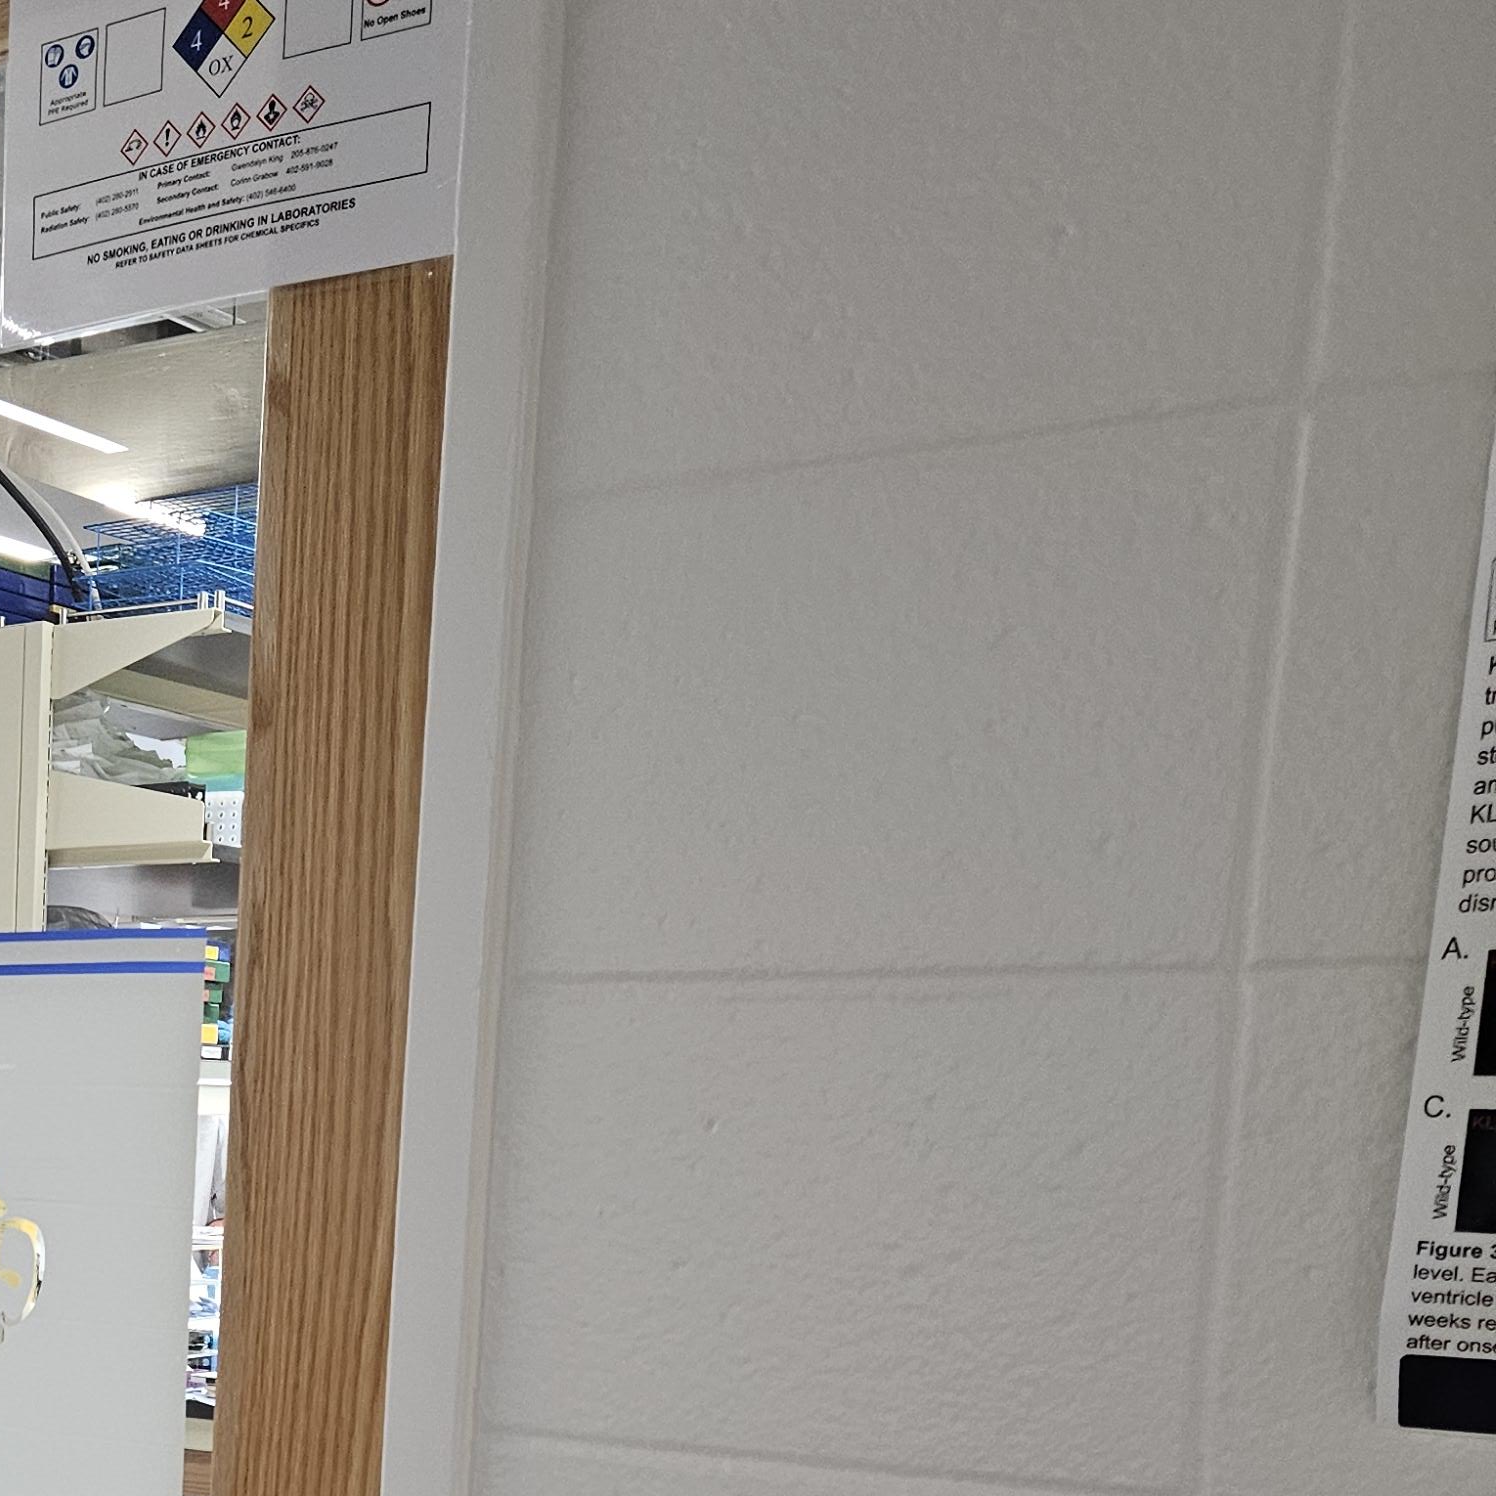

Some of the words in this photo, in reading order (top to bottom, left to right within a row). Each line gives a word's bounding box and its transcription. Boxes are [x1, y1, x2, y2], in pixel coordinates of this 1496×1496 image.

[241, 16, 253, 39] 2
[364, 18, 375, 28] No
[377, 13, 398, 27] Open
[400, 6, 426, 19] Shoes
[190, 29, 203, 51] 4
[208, 54, 234, 76] OX
[138, 170, 148, 181] IN
[150, 165, 174, 179] CASE
[176, 160, 189, 171] OF
[191, 145, 250, 168] EMERGENCY
[252, 134, 301, 154] CONTACT:
[157, 177, 181, 190] Primary
[184, 171, 211, 184] Contact:
[87, 253, 100, 265] NO
[102, 241, 148, 262] SMOKING,
[151, 232, 186, 249] EATING
[188, 228, 203, 241] OR
[205, 217, 255, 237] DRINKING
[257, 214, 268, 227] IN
[271, 197, 356, 225] LABORATORIES
[115, 256, 137, 269] REFER
[139, 253, 148, 264] TO
[149, 246, 175, 261] SAFETY
[176, 243, 194, 256] DATA
[195, 238, 223, 251] SHEETS
[224, 235, 239, 245] FOR
[240, 226, 278, 242] CHEMICAL
[280, 218, 320, 234] SPECIFICS
[1441, 936, 1469, 960] A.
[1451, 986, 1475, 1063] Wild-type
[1424, 1095, 1451, 1118] C.
[1432, 1145, 1456, 1220] Wild-type
[1416, 1240, 1483, 1261] Figure
[1413, 1264, 1464, 1282] level.
[1411, 1289, 1494, 1308] ventricle
[1408, 1313, 1472, 1330] weeks
[1406, 1334, 1452, 1351] after
